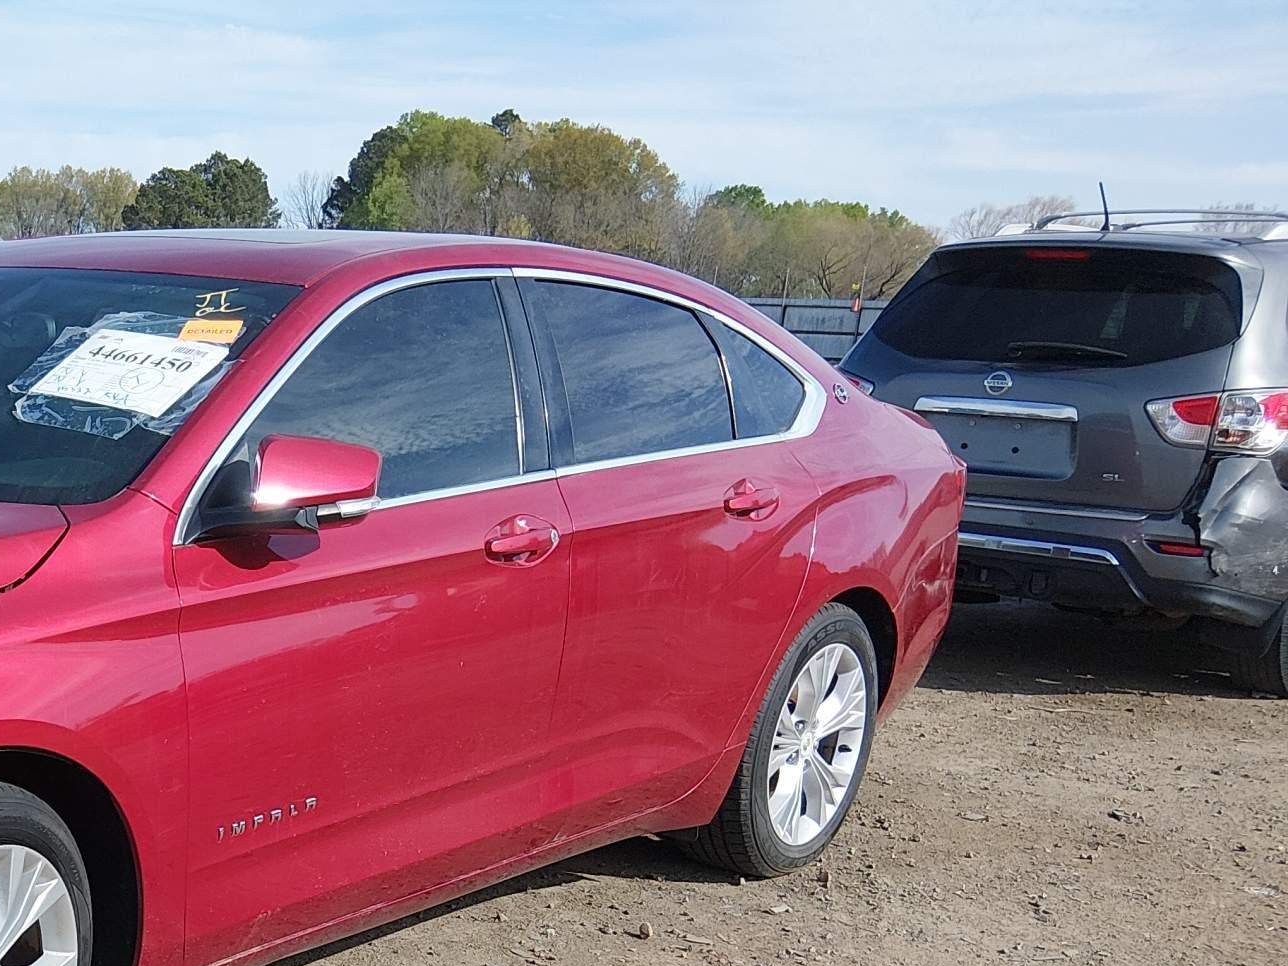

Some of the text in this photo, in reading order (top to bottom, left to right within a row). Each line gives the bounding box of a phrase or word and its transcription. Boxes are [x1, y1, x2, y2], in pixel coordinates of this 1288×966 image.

[186, 328, 233, 336] DETAILED
[88, 344, 193, 373] 44661450
[1101, 473, 1126, 482] SL
[216, 796, 318, 843] IMPALA
